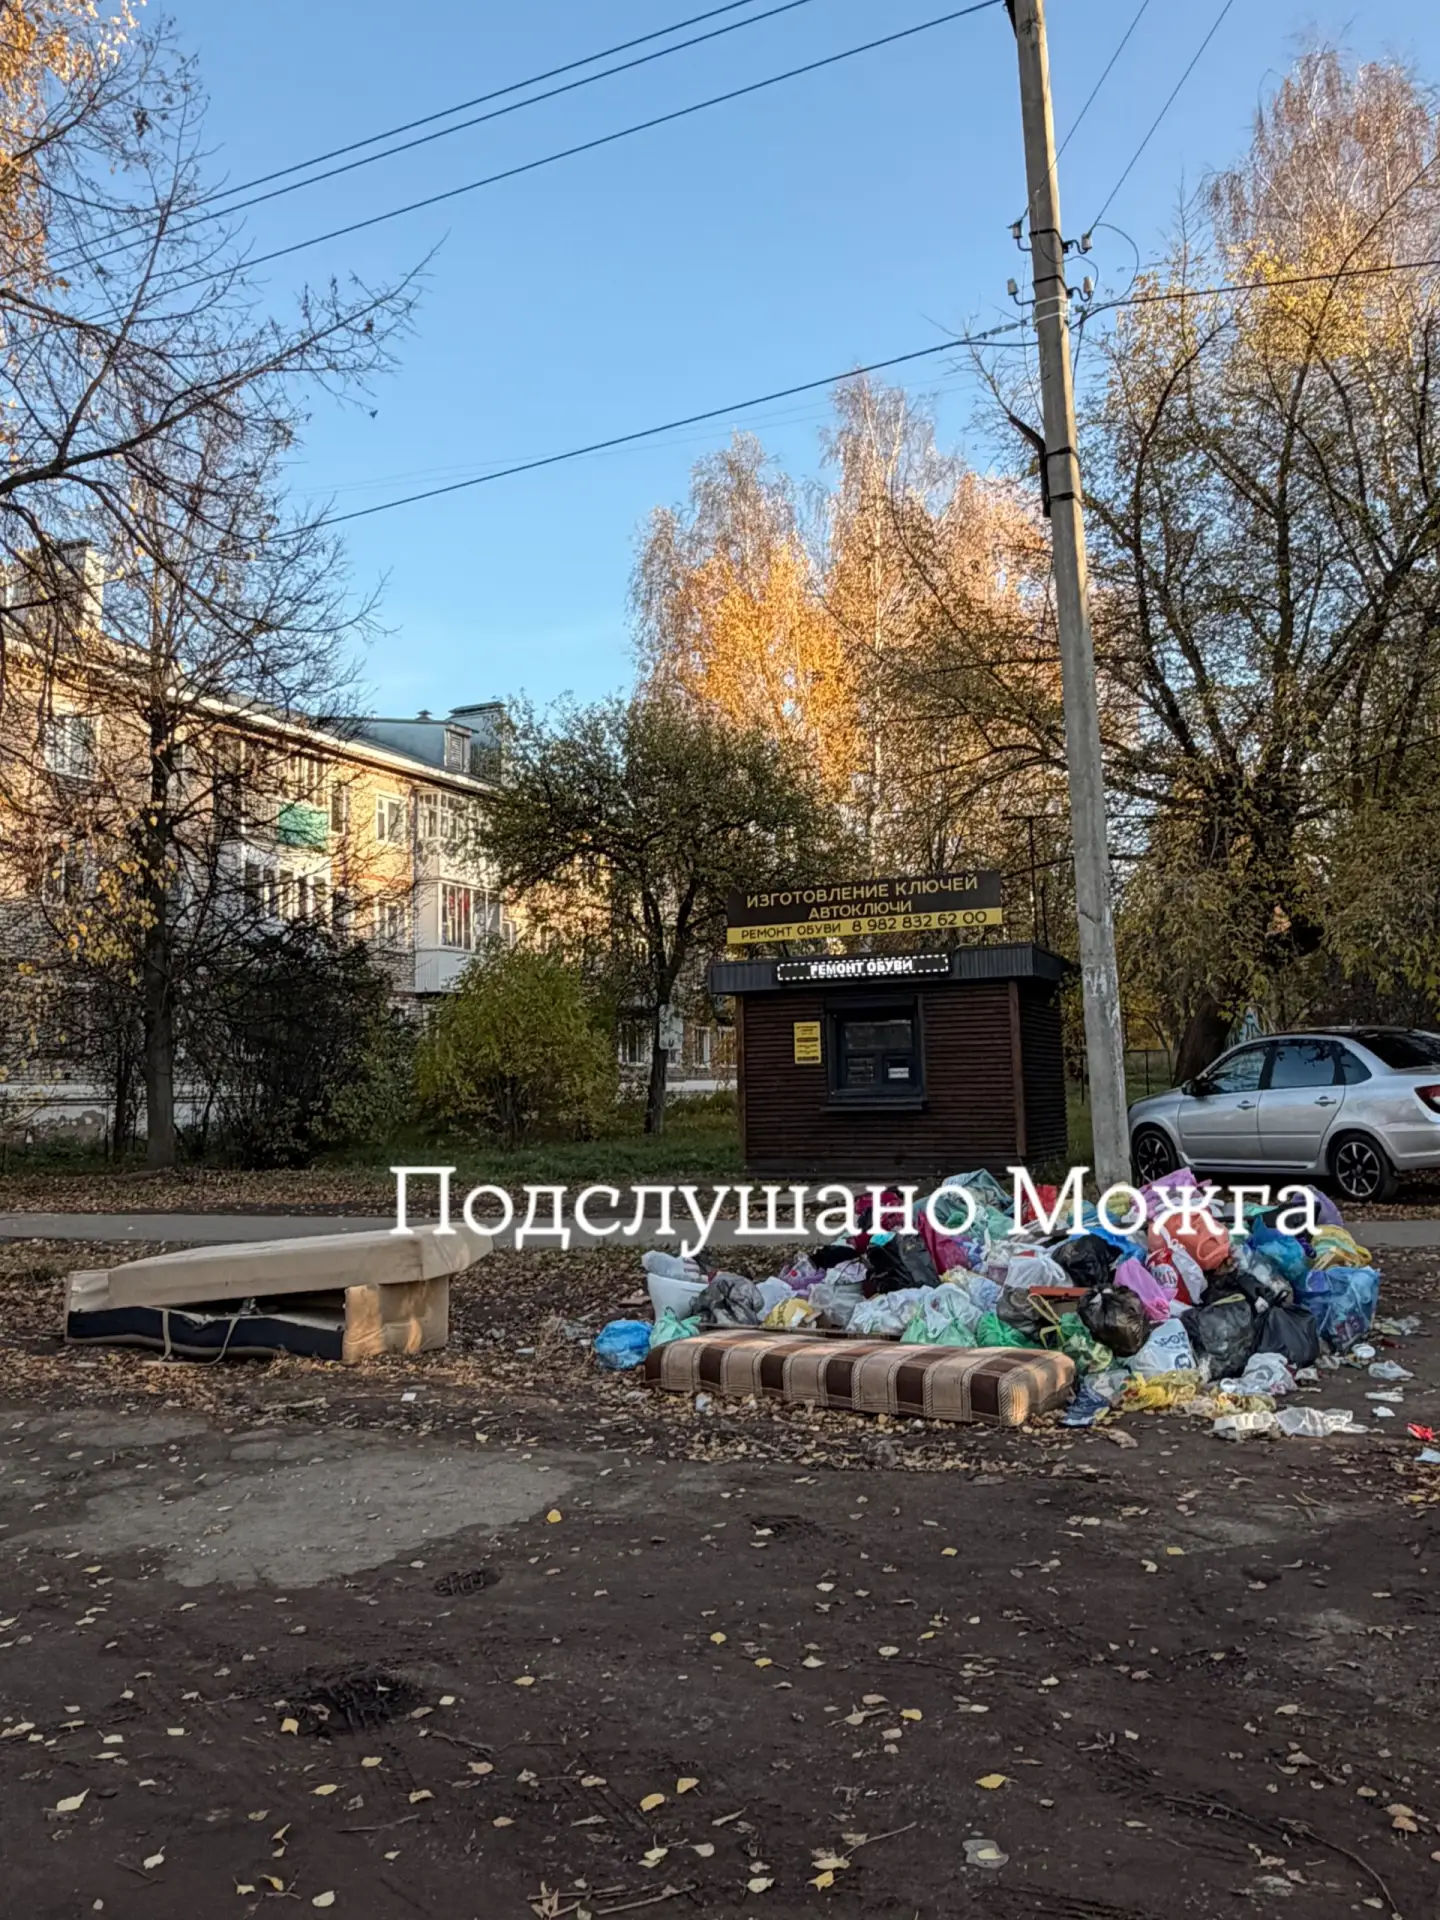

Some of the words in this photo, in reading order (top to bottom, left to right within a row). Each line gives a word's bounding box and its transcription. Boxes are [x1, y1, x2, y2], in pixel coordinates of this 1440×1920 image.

[746, 883, 889, 908] ИЗГОТОВЛЕНИЕ
[895, 875, 978, 896] КЛЮЧЕЙ
[808, 900, 912, 921] АВТОКЛЮЧИ
[741, 927, 792, 940] РЕМОНТ
[797, 923, 841, 935] ОБУВИ
[852, 920, 862, 933] 8
[867, 917, 897, 932] 982
[902, 914, 932, 929] 832
[939, 912, 957, 926] 62
[810, 962, 862, 976] РЕМОНТ
[867, 959, 912, 974] ОБУВИ
